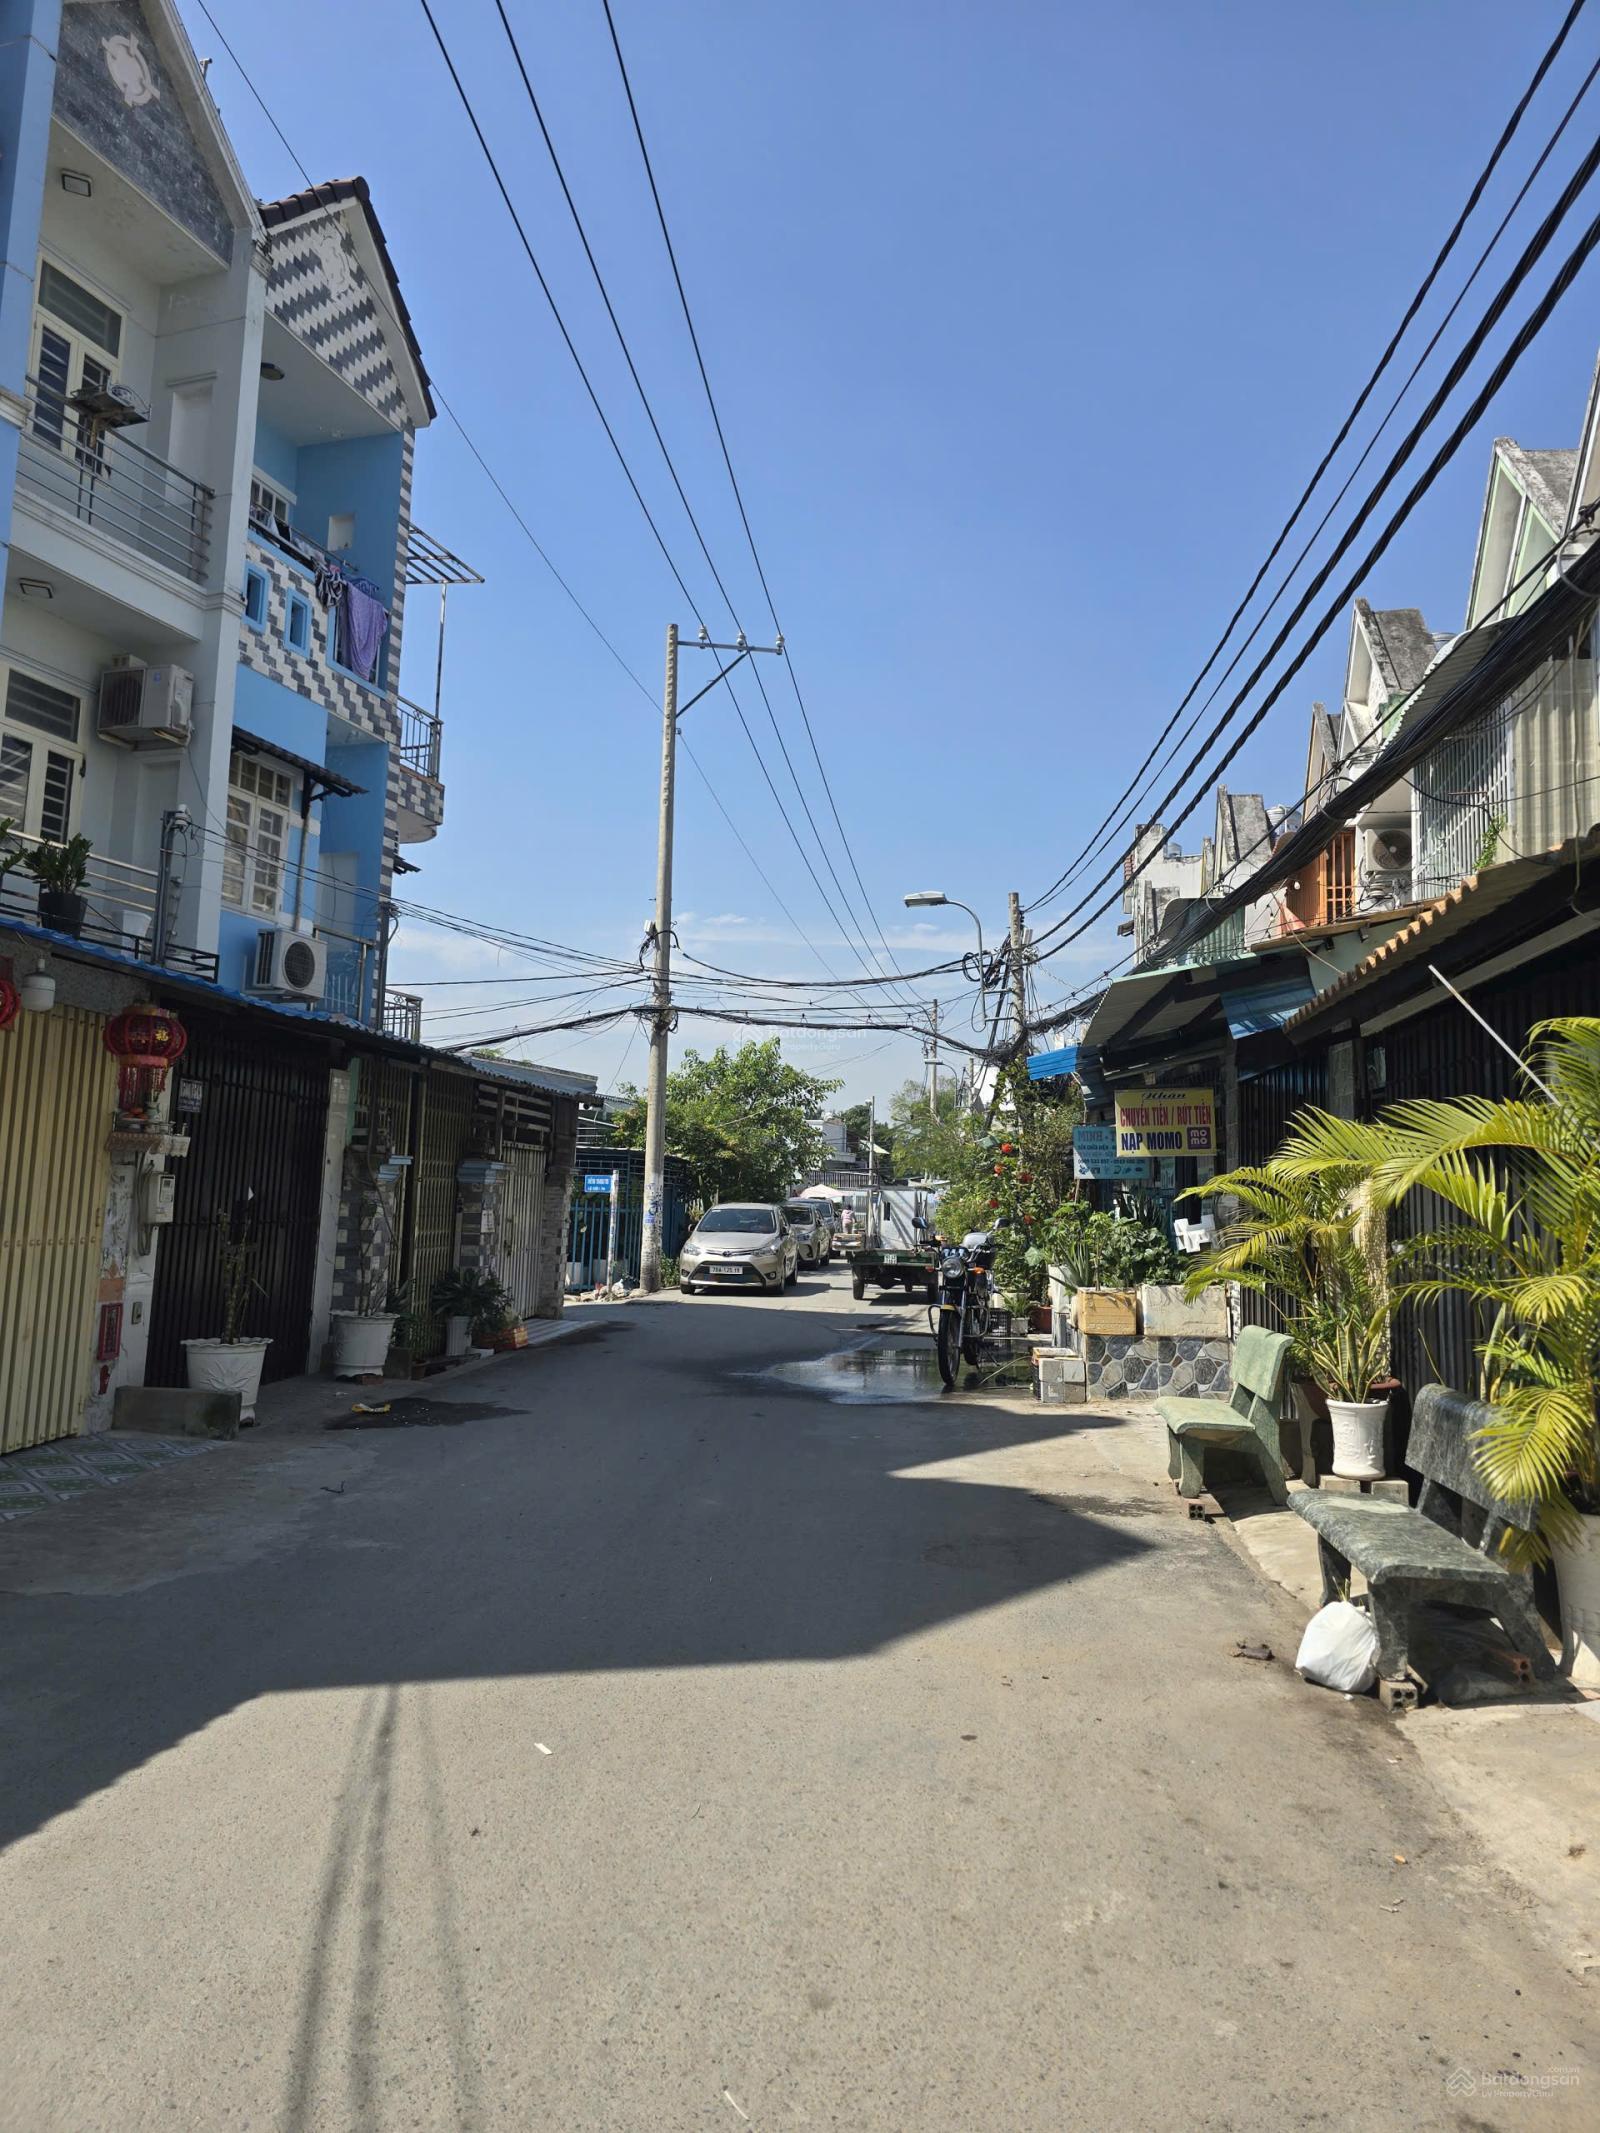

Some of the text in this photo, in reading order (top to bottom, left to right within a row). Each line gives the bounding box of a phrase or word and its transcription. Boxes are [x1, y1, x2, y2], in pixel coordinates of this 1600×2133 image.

[1177, 1102, 1192, 1125] RÚT
[1194, 1099, 1212, 1124] TIỀN
[1121, 1132, 1143, 1153] NẠP
[1146, 1131, 1182, 1150] MOMO
